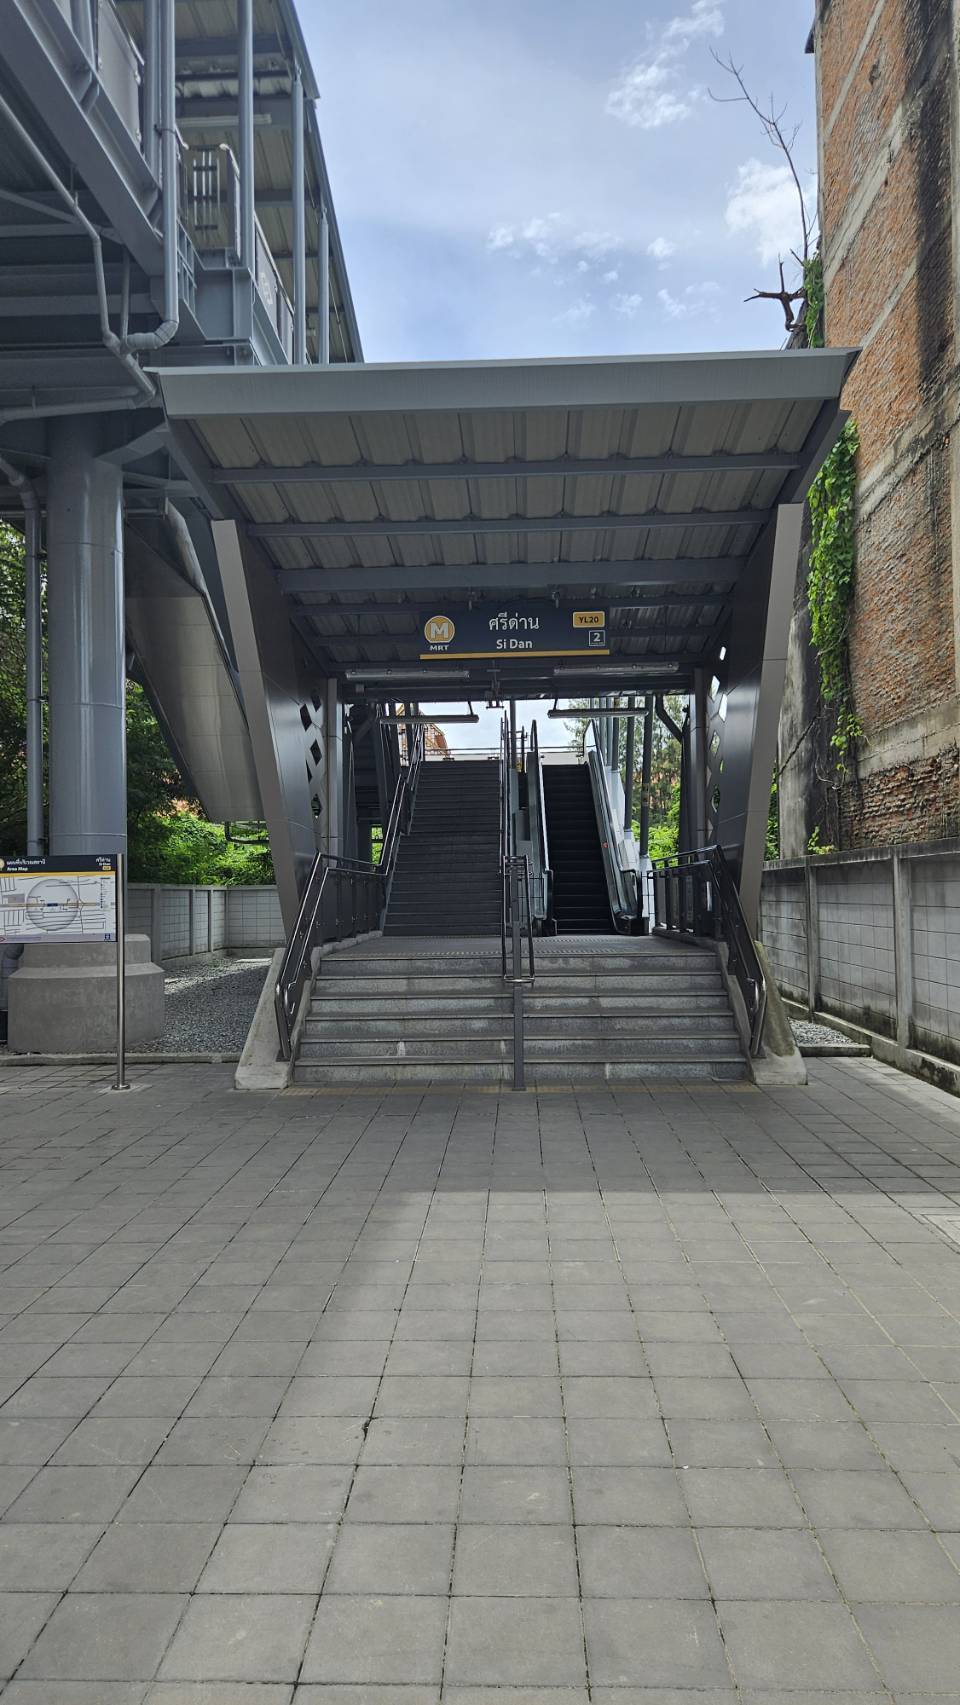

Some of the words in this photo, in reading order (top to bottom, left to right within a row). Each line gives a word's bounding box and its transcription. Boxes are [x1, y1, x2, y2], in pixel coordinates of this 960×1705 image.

[488, 612, 540, 631] ศรีด่าน
[578, 616, 599, 624] YL20
[593, 632, 601, 642] 2
[496, 638, 507, 650] Si
[509, 638, 533, 650] Dan
